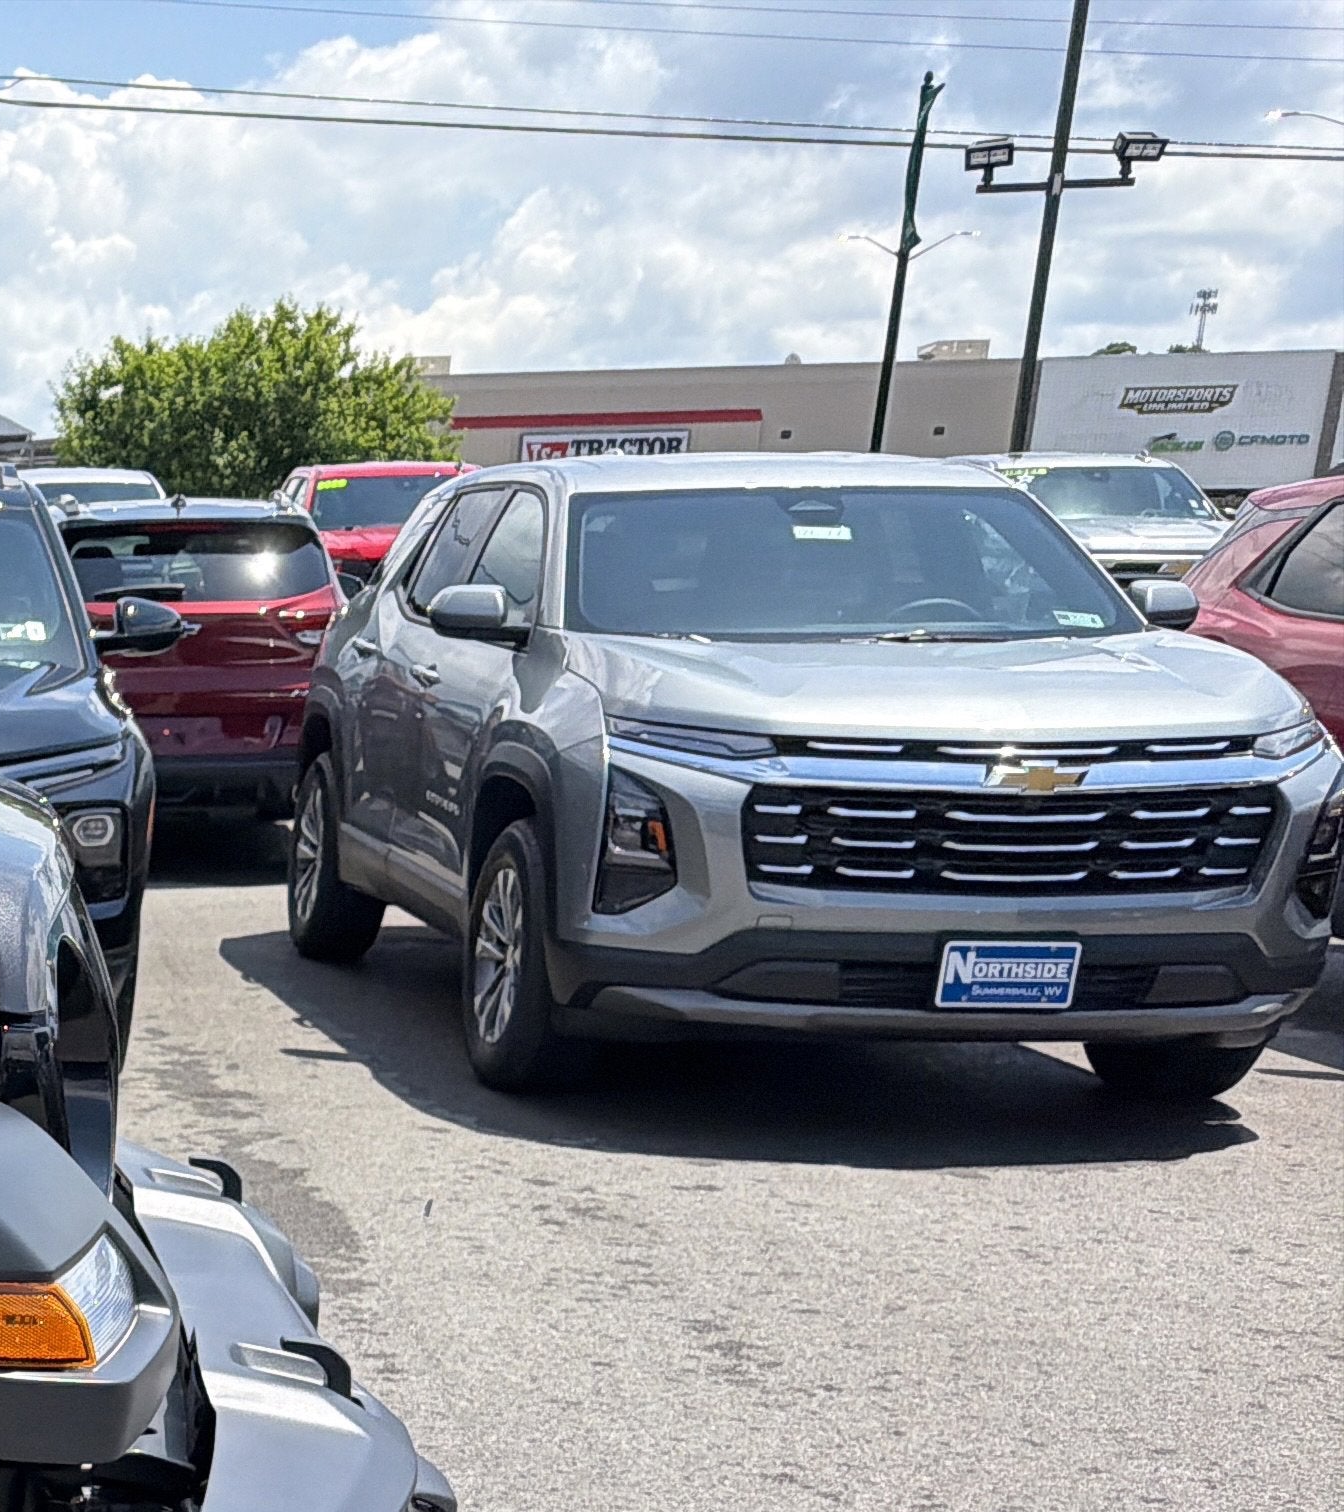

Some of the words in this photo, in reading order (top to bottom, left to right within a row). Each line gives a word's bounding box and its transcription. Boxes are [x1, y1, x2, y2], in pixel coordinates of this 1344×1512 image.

[1125, 387, 1234, 404] MOTORSPORTS
[1142, 402, 1211, 411] UNLIMITED
[571, 437, 684, 456] TRACTOR
[1238, 433, 1311, 447] CFMOTO
[945, 952, 1070, 984] NORTHSIDE
[1043, 985, 1063, 997] WV
